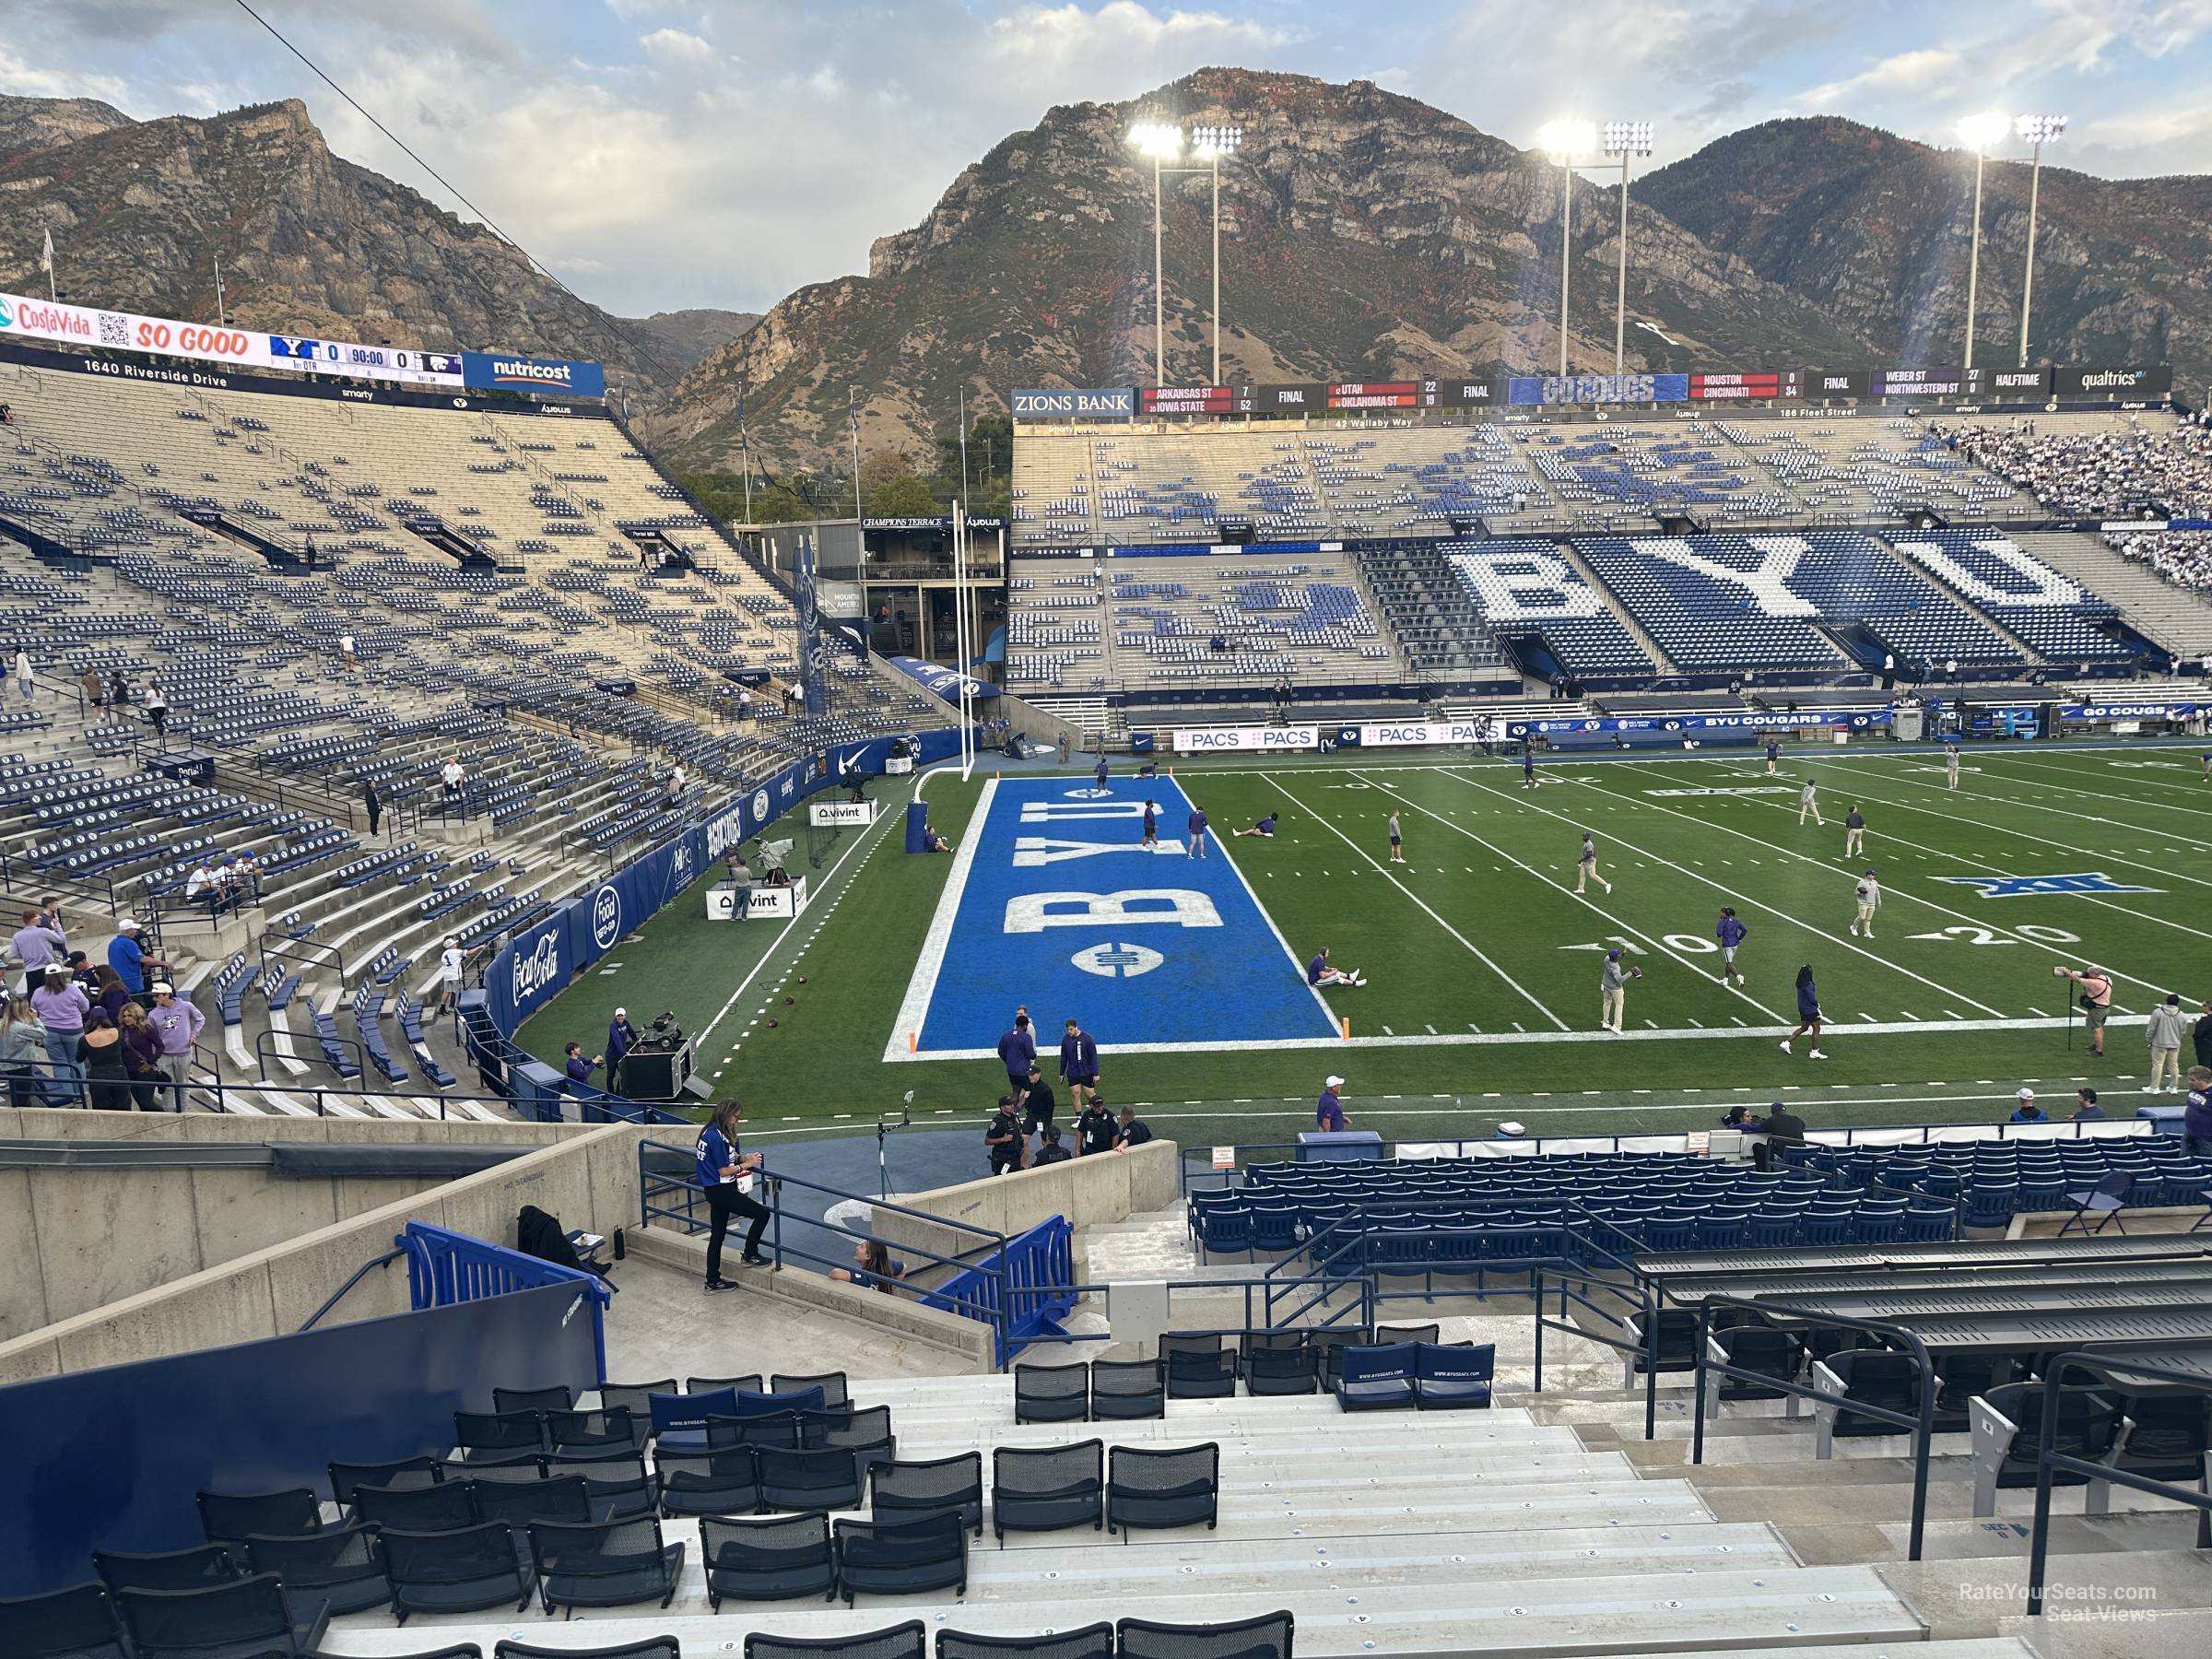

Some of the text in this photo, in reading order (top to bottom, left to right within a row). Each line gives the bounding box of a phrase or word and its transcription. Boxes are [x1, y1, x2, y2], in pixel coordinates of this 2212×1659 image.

[136, 322, 248, 355] SO GOOD
[328, 345, 338, 360] 0
[353, 349, 383, 365] 90:00
[396, 352, 407, 368] 0
[84, 359, 227, 387] 1640 Riverside Drive
[493, 360, 571, 380] nutricost
[1968, 370, 1979, 380] 27
[1703, 374, 1742, 385] HOUSTON
[1789, 372, 1794, 382] 0
[1886, 371, 1925, 382] WEBER ST
[1995, 373, 2040, 386] HALFTIME
[2082, 370, 2136, 391] qualtrics
[1342, 383, 1363, 394] UTAH
[1425, 381, 1436, 392] 22
[1542, 376, 1573, 404] GO
[1823, 378, 1849, 390] FINAL
[1886, 382, 1959, 394] NORTHWESTERN ST
[1970, 382, 1975, 393] 0
[342, 388, 373, 401] smarty
[1156, 388, 1213, 400] ARKANSAS ST
[1242, 386, 1249, 397] 7
[1278, 390, 1304, 403] FINAL
[1463, 385, 1489, 398] FINAL
[1703, 386, 1749, 398] CINCINNATI
[1785, 385, 1797, 397] 34
[1015, 394, 1130, 411] ZIONS BANK
[1240, 400, 1252, 411] 52
[1342, 396, 1386, 408] OKLAHOMA
[1387, 395, 1398, 406] ST
[1426, 394, 1435, 406] 19
[1157, 402, 1180, 412] IOWA
[1180, 401, 1205, 412] STATE
[1780, 407, 1857, 418] 186 Fleet Street
[1955, 405, 1982, 414] smarty
[1335, 418, 1413, 429] 42 Wallaby Way
[1504, 415, 1530, 423] smarty
[863, 518, 942, 526] CHAMPIONS TERRACE
[2083, 706, 2166, 716] GO COUGS
[1706, 715, 1821, 725] BYU COUGARS
[1192, 732, 1240, 747] PACS
[1263, 730, 1311, 745] PACS
[1379, 727, 1428, 743] PACS
[598, 894, 616, 924] Food
[1944, 924, 2082, 945] 20
